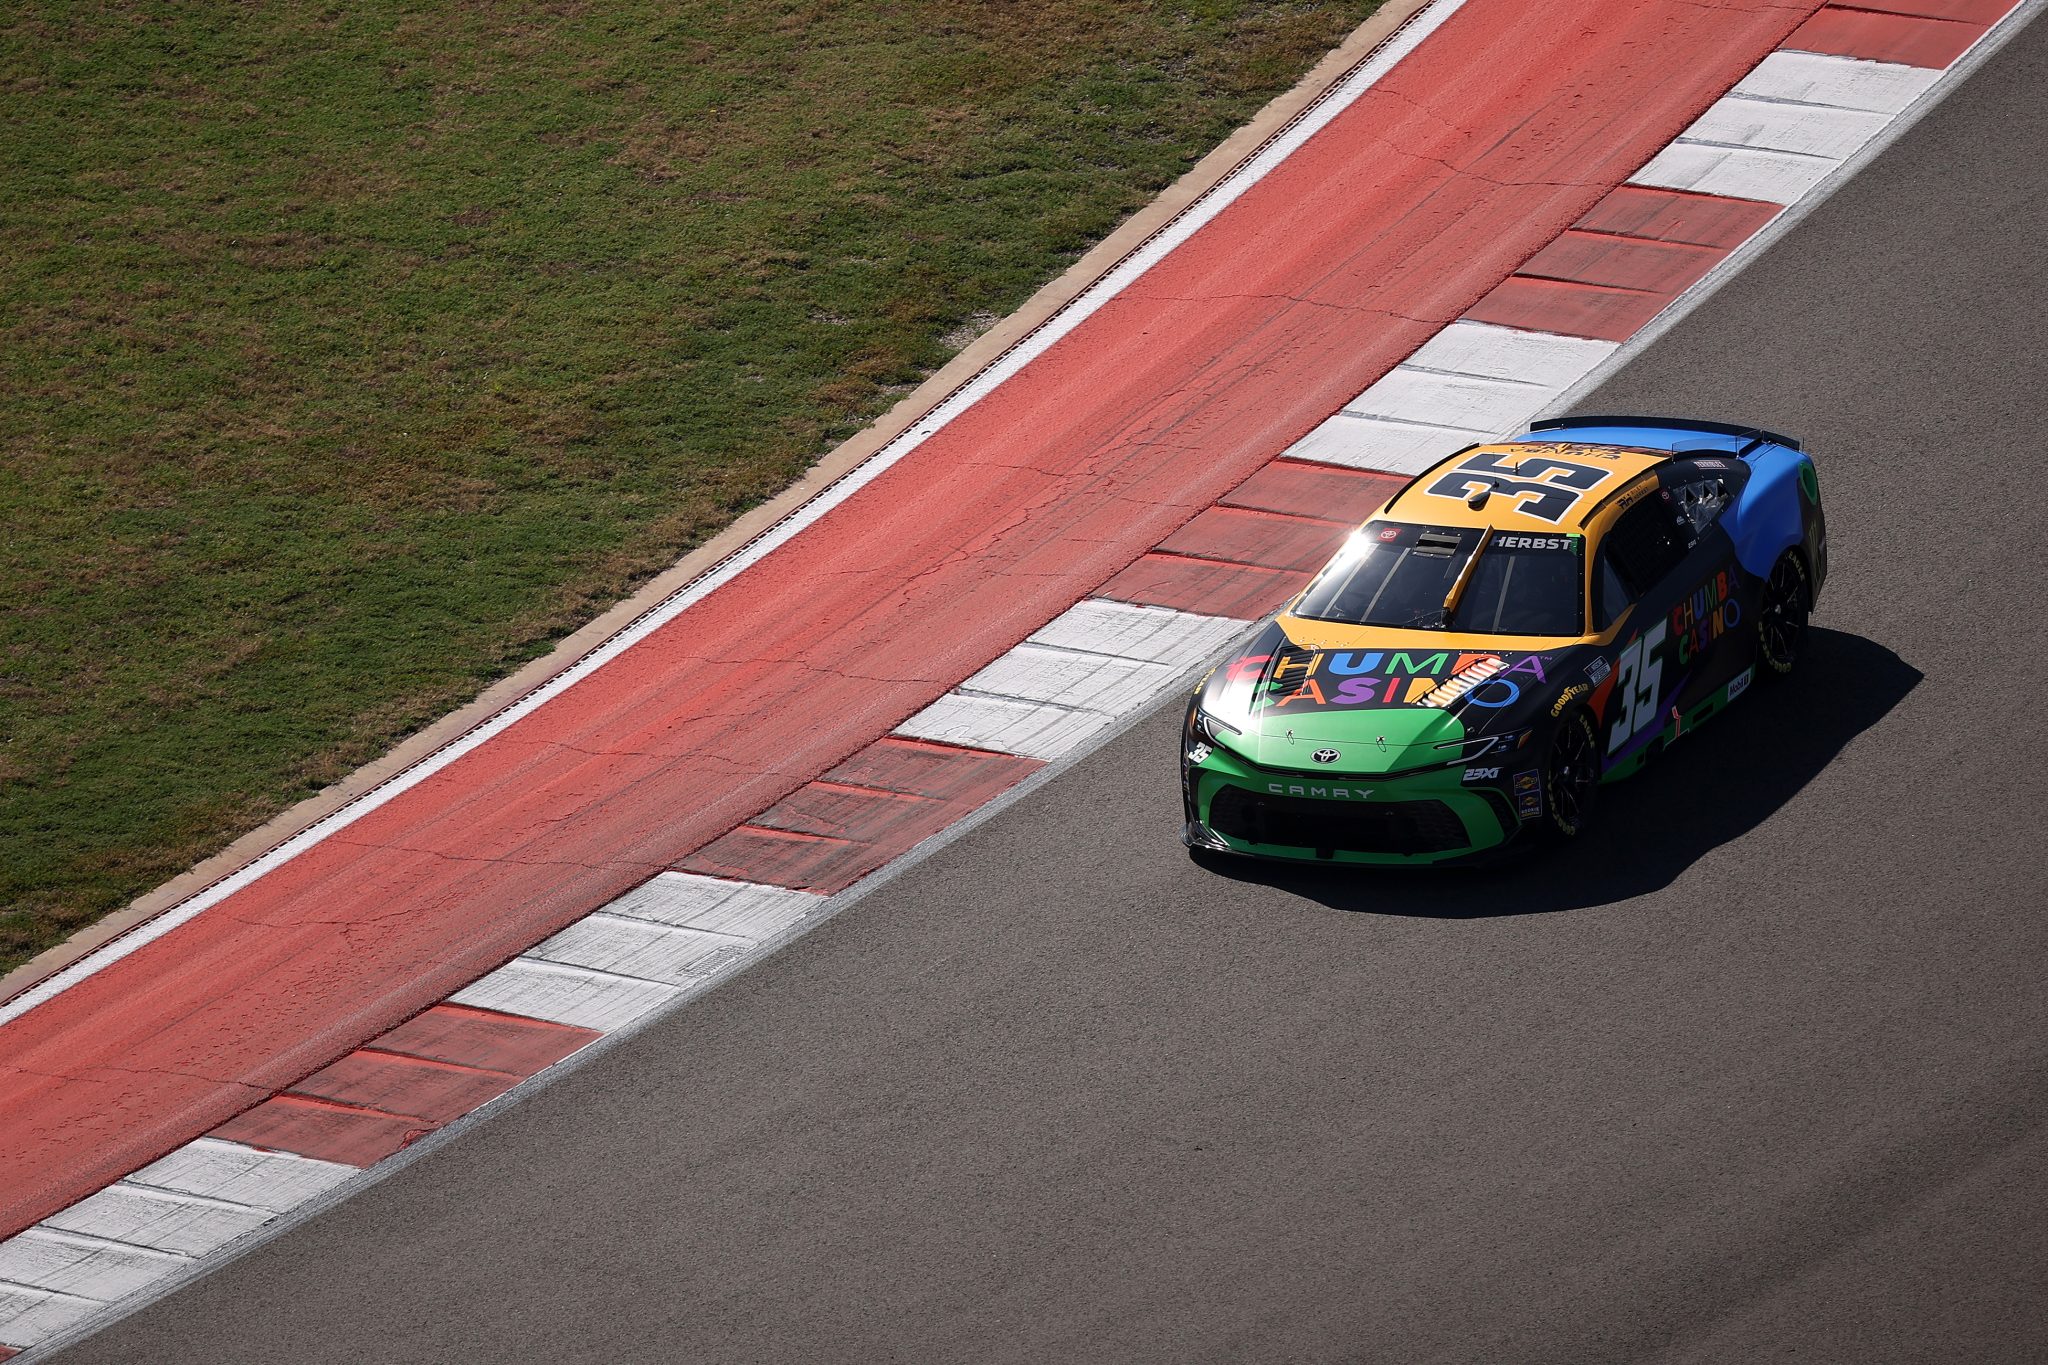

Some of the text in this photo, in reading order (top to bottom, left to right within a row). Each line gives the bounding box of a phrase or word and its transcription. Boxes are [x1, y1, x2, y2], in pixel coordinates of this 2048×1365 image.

[1424, 452, 1614, 525] 35
[1490, 536, 1572, 550] HERBST
[1672, 563, 1740, 637] CHUMBA
[1679, 598, 1741, 665] CASINO
[1550, 682, 1589, 718] GOODYEAR
[1607, 617, 1667, 756] 35
[1187, 741, 1213, 764] 35
[1268, 783, 1375, 799] CAMRY
[1463, 767, 1503, 780] 23XI
